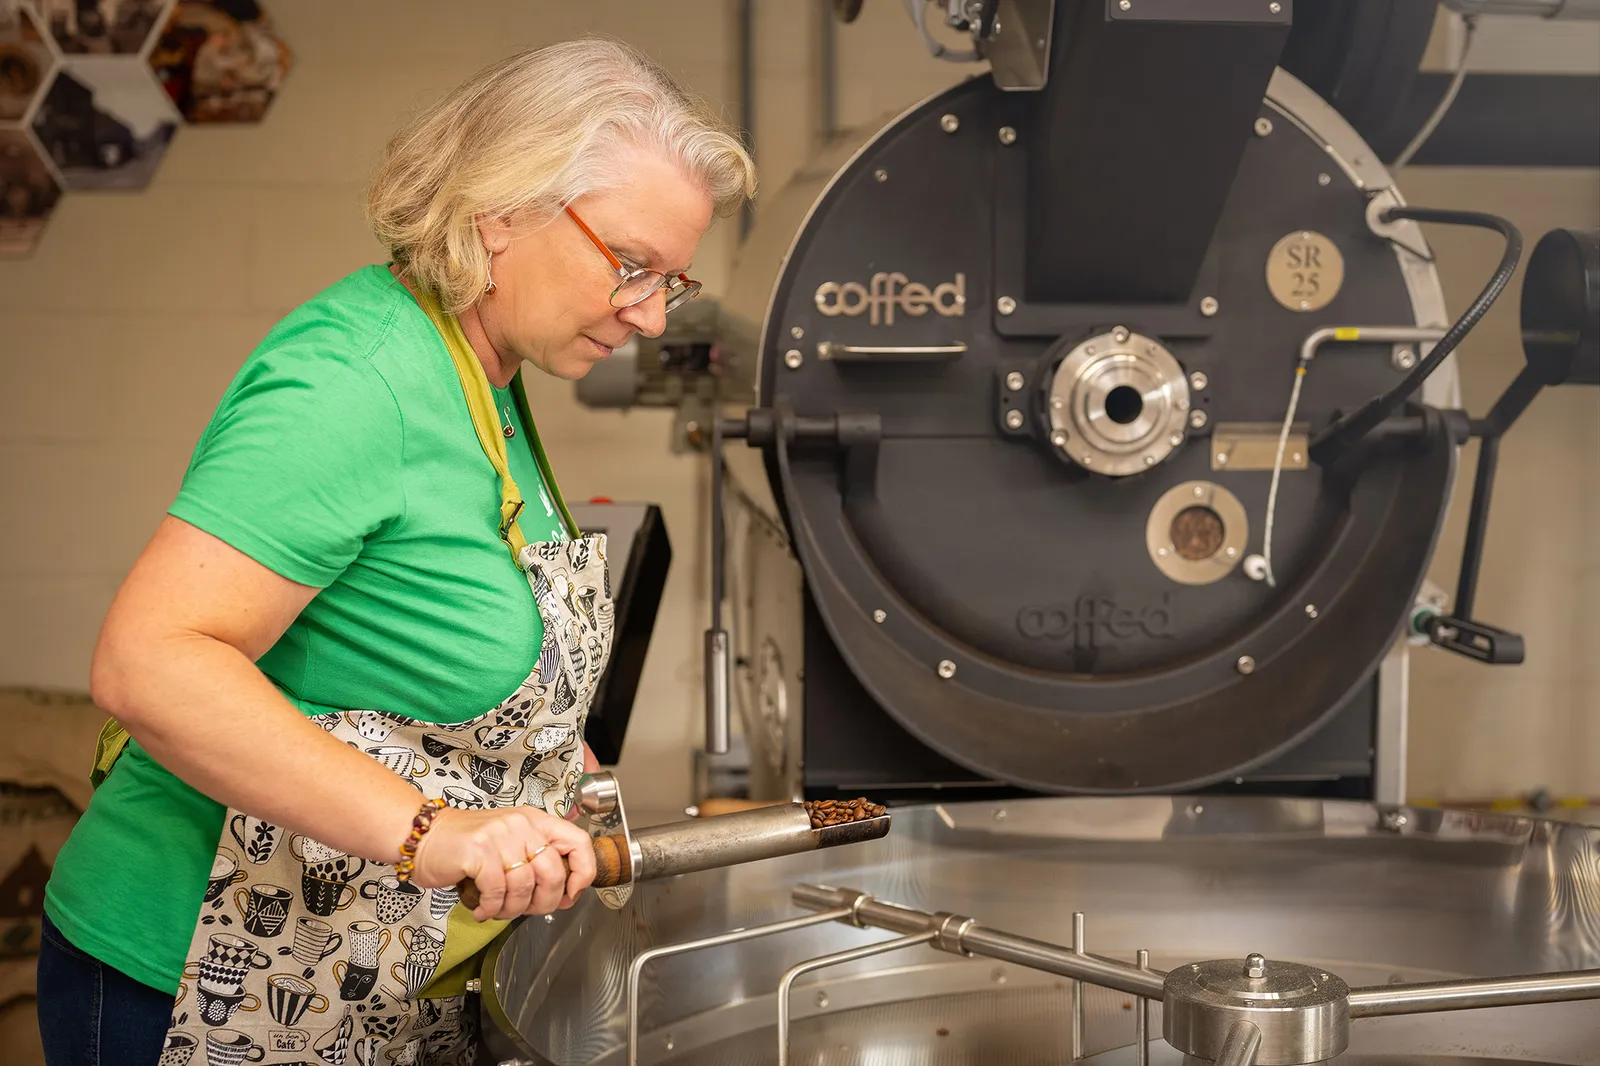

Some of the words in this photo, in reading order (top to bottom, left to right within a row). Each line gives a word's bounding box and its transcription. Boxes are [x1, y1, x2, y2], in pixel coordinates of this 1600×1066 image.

[1285, 244, 1322, 269] SR
[1290, 272, 1320, 297] 25
[814, 271, 966, 327] coffed
[1015, 590, 1175, 648] coffed
[276, 1038, 296, 1050] Café
